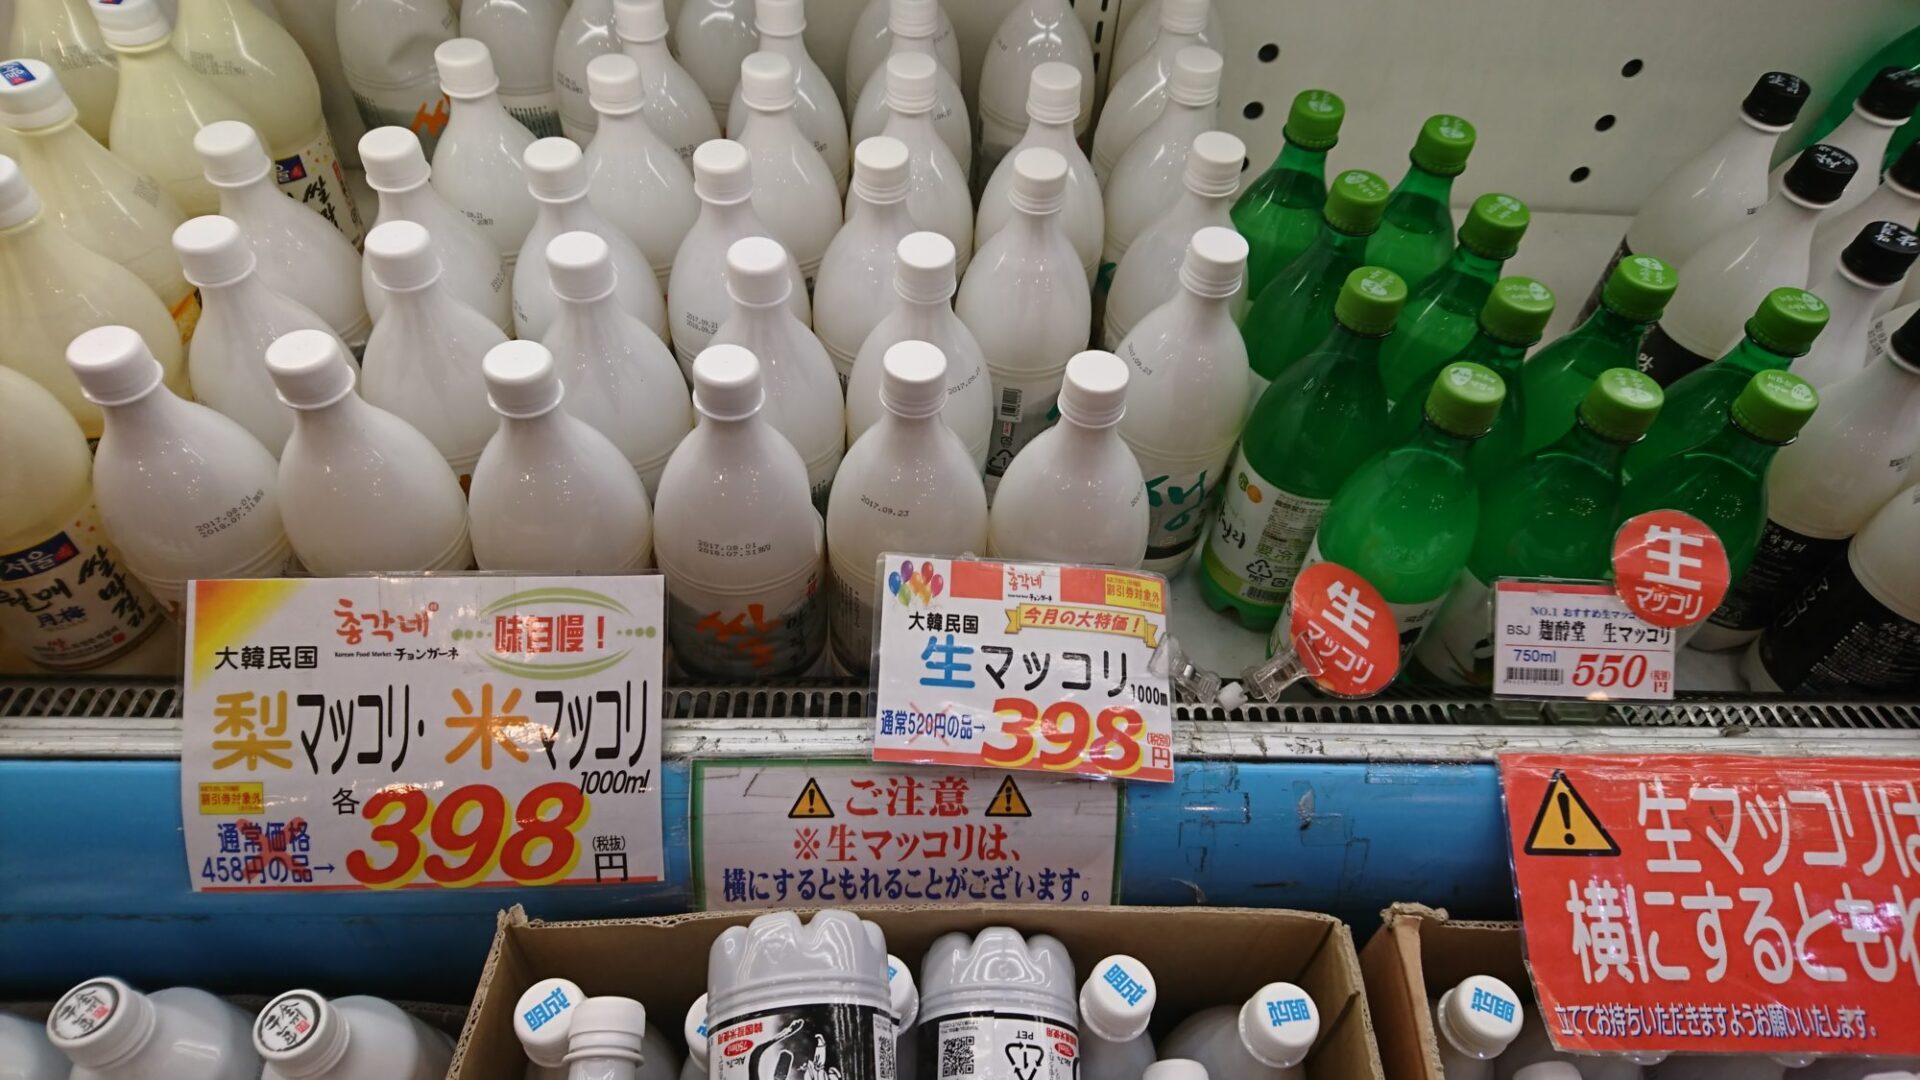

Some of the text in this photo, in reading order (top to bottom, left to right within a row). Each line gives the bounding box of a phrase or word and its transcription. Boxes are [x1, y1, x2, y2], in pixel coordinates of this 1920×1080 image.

[1643, 524, 1704, 591] 生
[1321, 580, 1376, 650] 生
[1530, 606, 1639, 619] NO.1 おすすめ生マッコ
[1634, 585, 1704, 620] マッコリ
[334, 598, 429, 645] 총각네
[495, 614, 605, 653] 味自慢！
[908, 611, 979, 634] 大韓民国
[1023, 607, 1141, 633] 今月の大特価！
[1507, 625, 1531, 635] BSJ
[1603, 624, 1671, 645] 生マッコリ
[214, 646, 318, 670] 大韓民国
[394, 647, 459, 661] チョンガーネ
[919, 634, 1127, 697] 生マッコリ
[1307, 619, 1375, 685] マッコリ
[1513, 649, 1557, 663] 750ml
[1571, 654, 1648, 688] 550
[1654, 681, 1668, 693] 円
[981, 697, 1147, 774] 398
[1151, 747, 1171, 768] 円
[332, 788, 360, 815] 各
[845, 776, 969, 817] ご注意
[217, 821, 311, 854] 通常価格
[345, 781, 586, 889] 398
[592, 835, 626, 851] (税抜)
[201, 854, 314, 884] 458円の品
[594, 852, 629, 882] 円
[722, 867, 1090, 903] 横にするともれることがございます。
[1015, 1030, 1034, 1041] PET
[1554, 1002, 1879, 1039] 立ててお持ちいただきますようお願いいたします。
